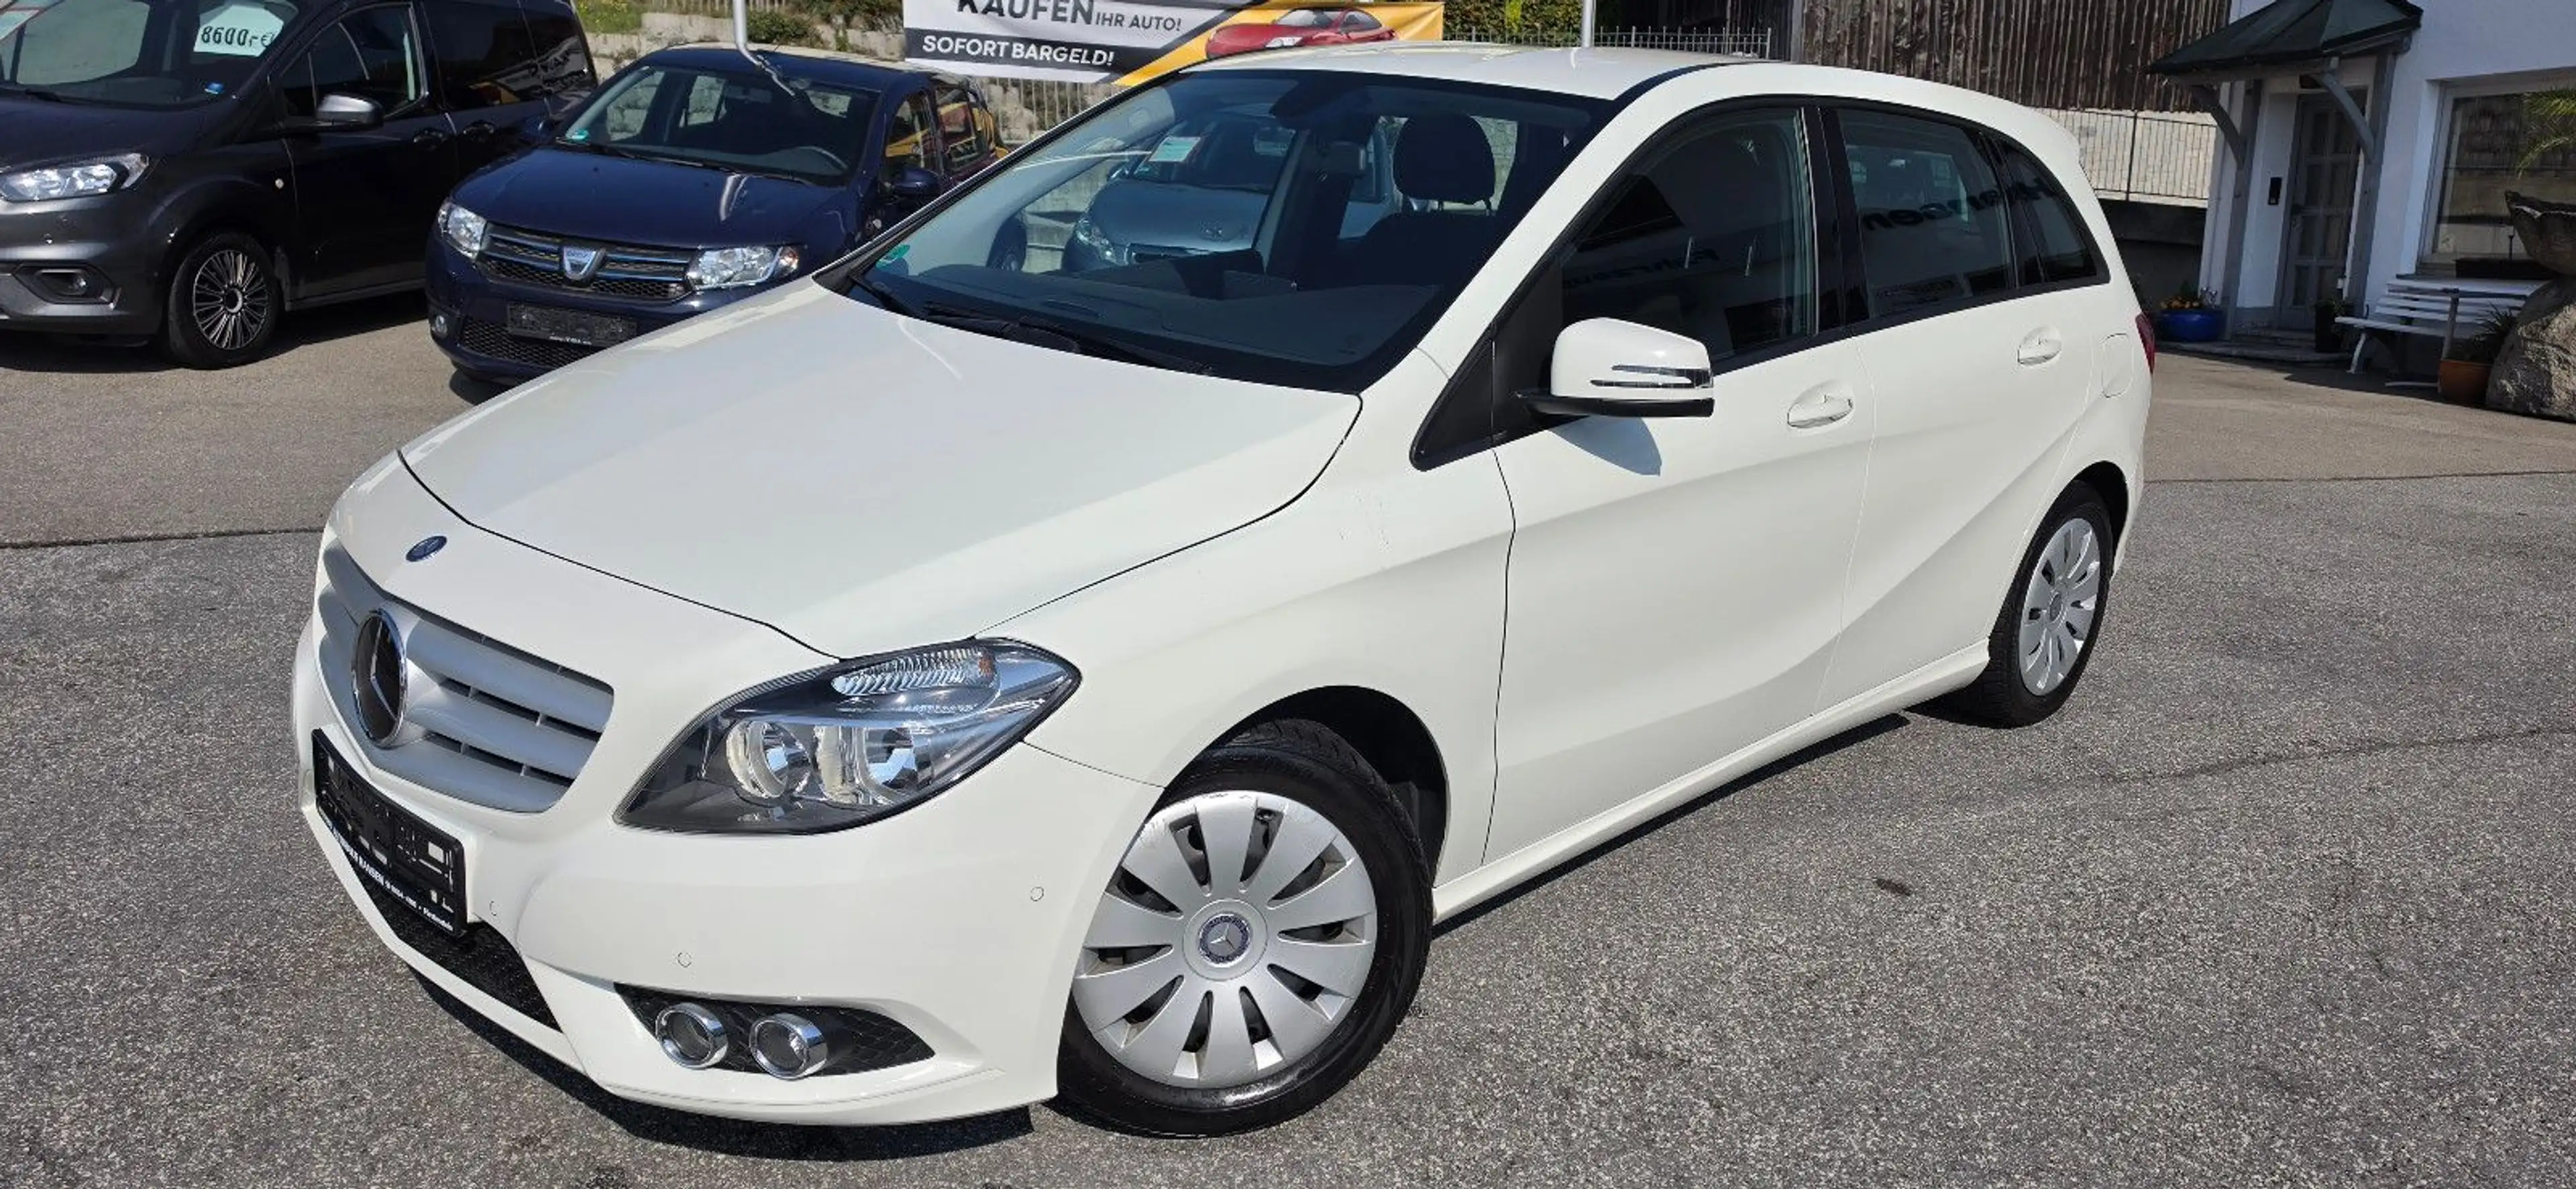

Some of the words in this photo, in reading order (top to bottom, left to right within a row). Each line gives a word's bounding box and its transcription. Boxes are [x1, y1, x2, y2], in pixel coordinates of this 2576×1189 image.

[957, 0, 1093, 25] KAUFEN
[1096, 12, 1124, 27] IHR
[1129, 15, 1181, 31] AUTO!
[922, 35, 1010, 57] SOFORT
[1011, 42, 1114, 66] BARGELD!
